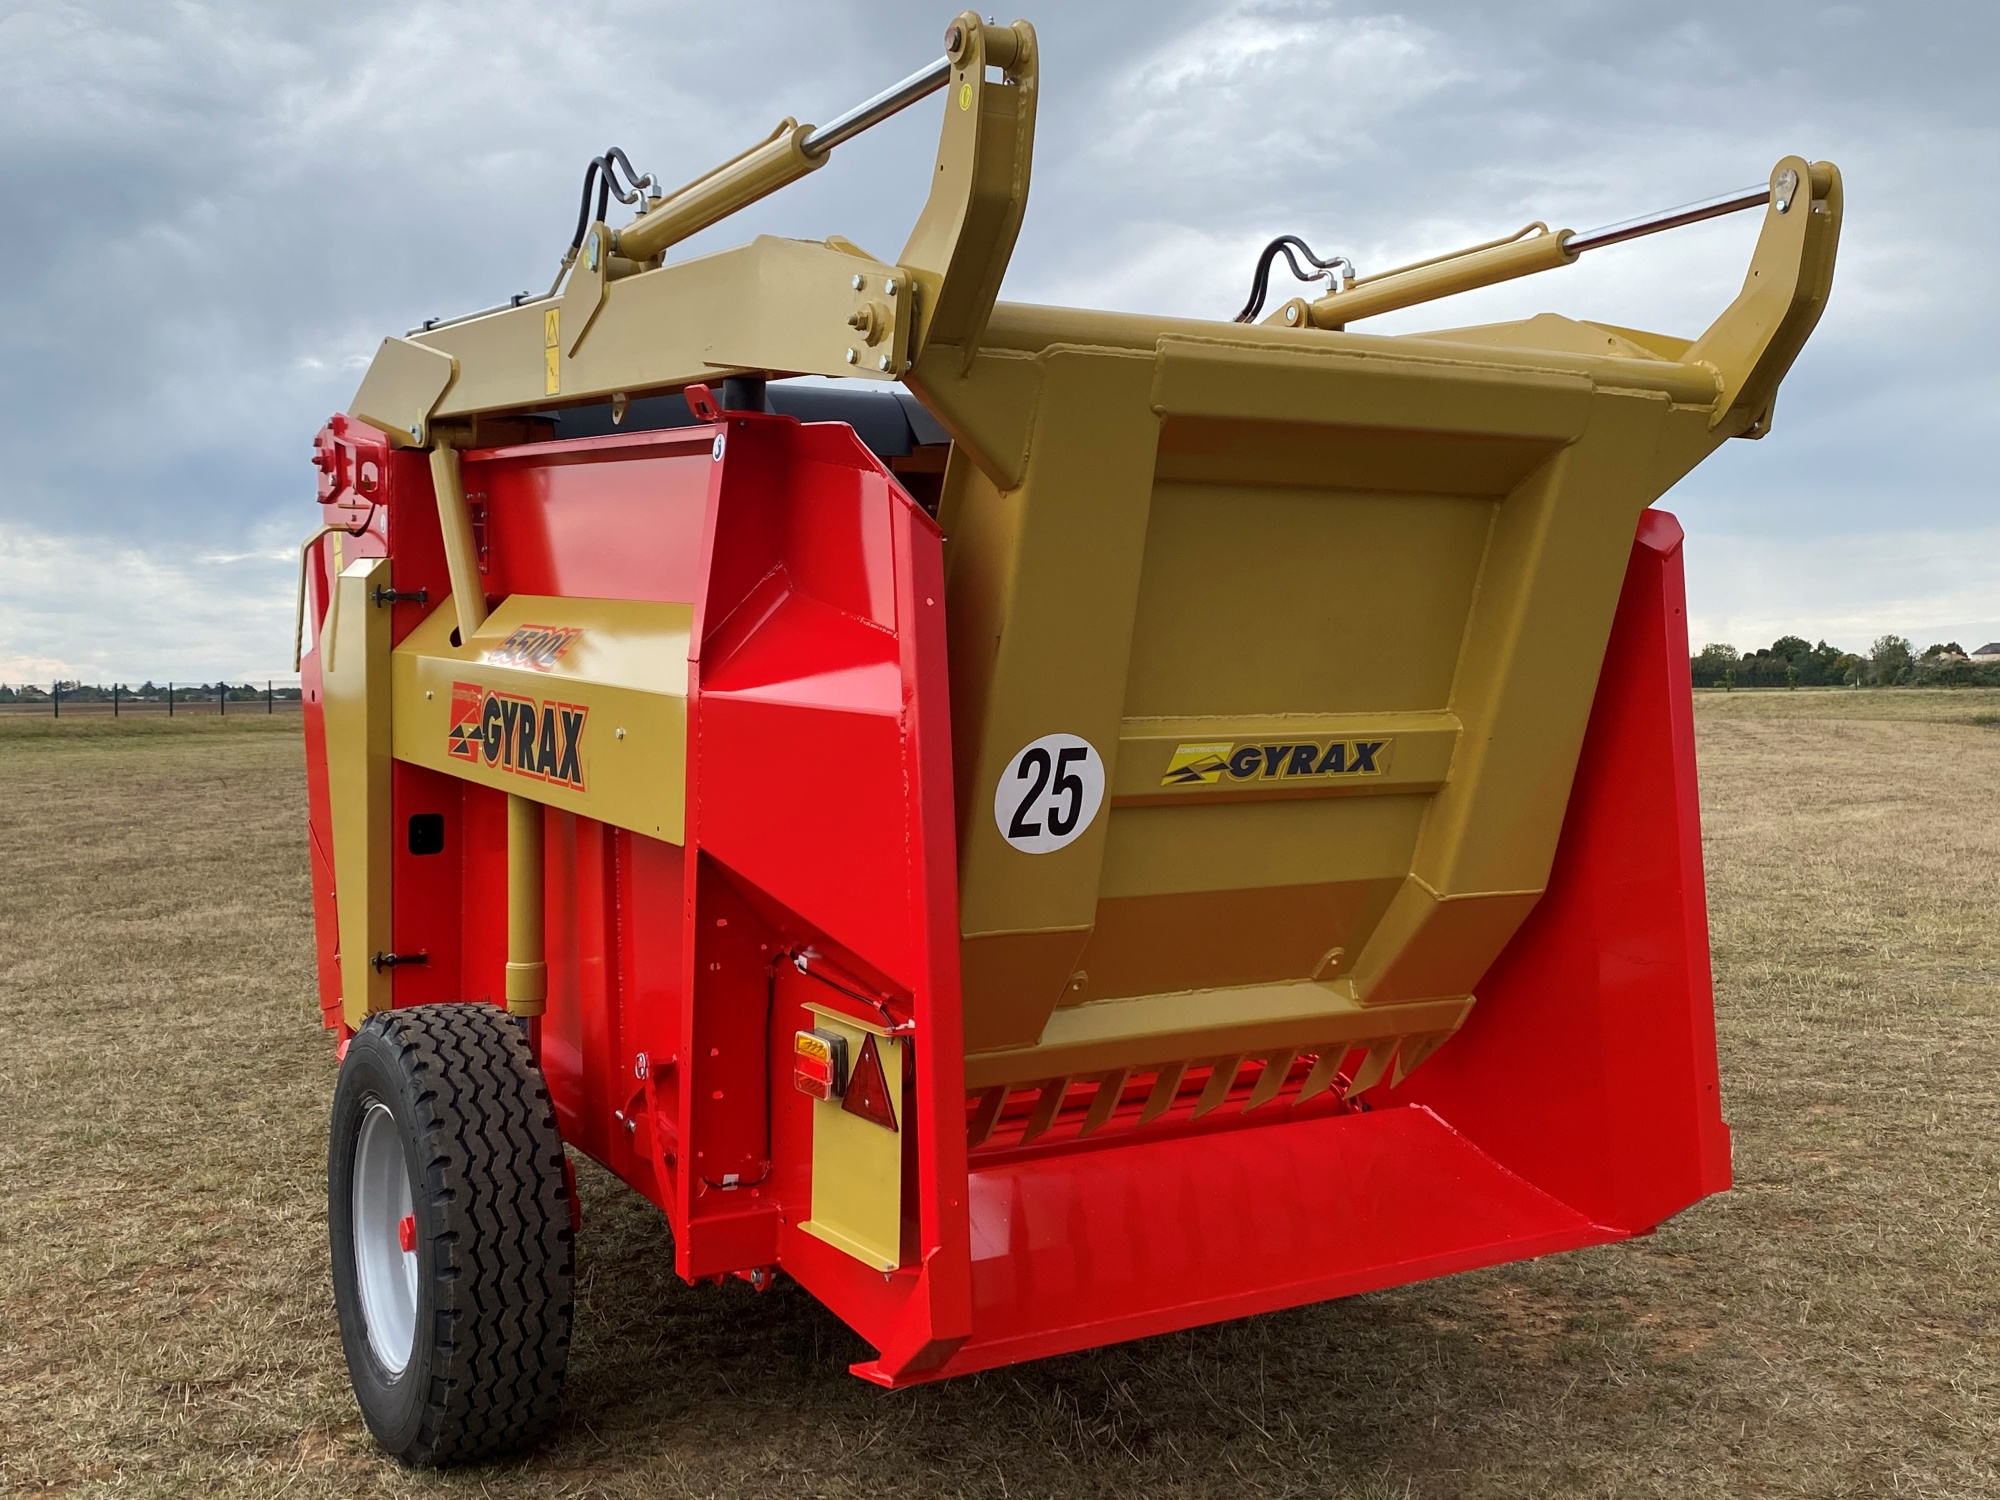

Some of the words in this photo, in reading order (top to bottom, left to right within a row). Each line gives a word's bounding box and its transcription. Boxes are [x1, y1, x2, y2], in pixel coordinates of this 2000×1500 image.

[492, 628, 574, 666] 5500L
[482, 696, 584, 785] GYRAX
[1229, 741, 1386, 778] GYRAX
[1008, 747, 1088, 839] 25
